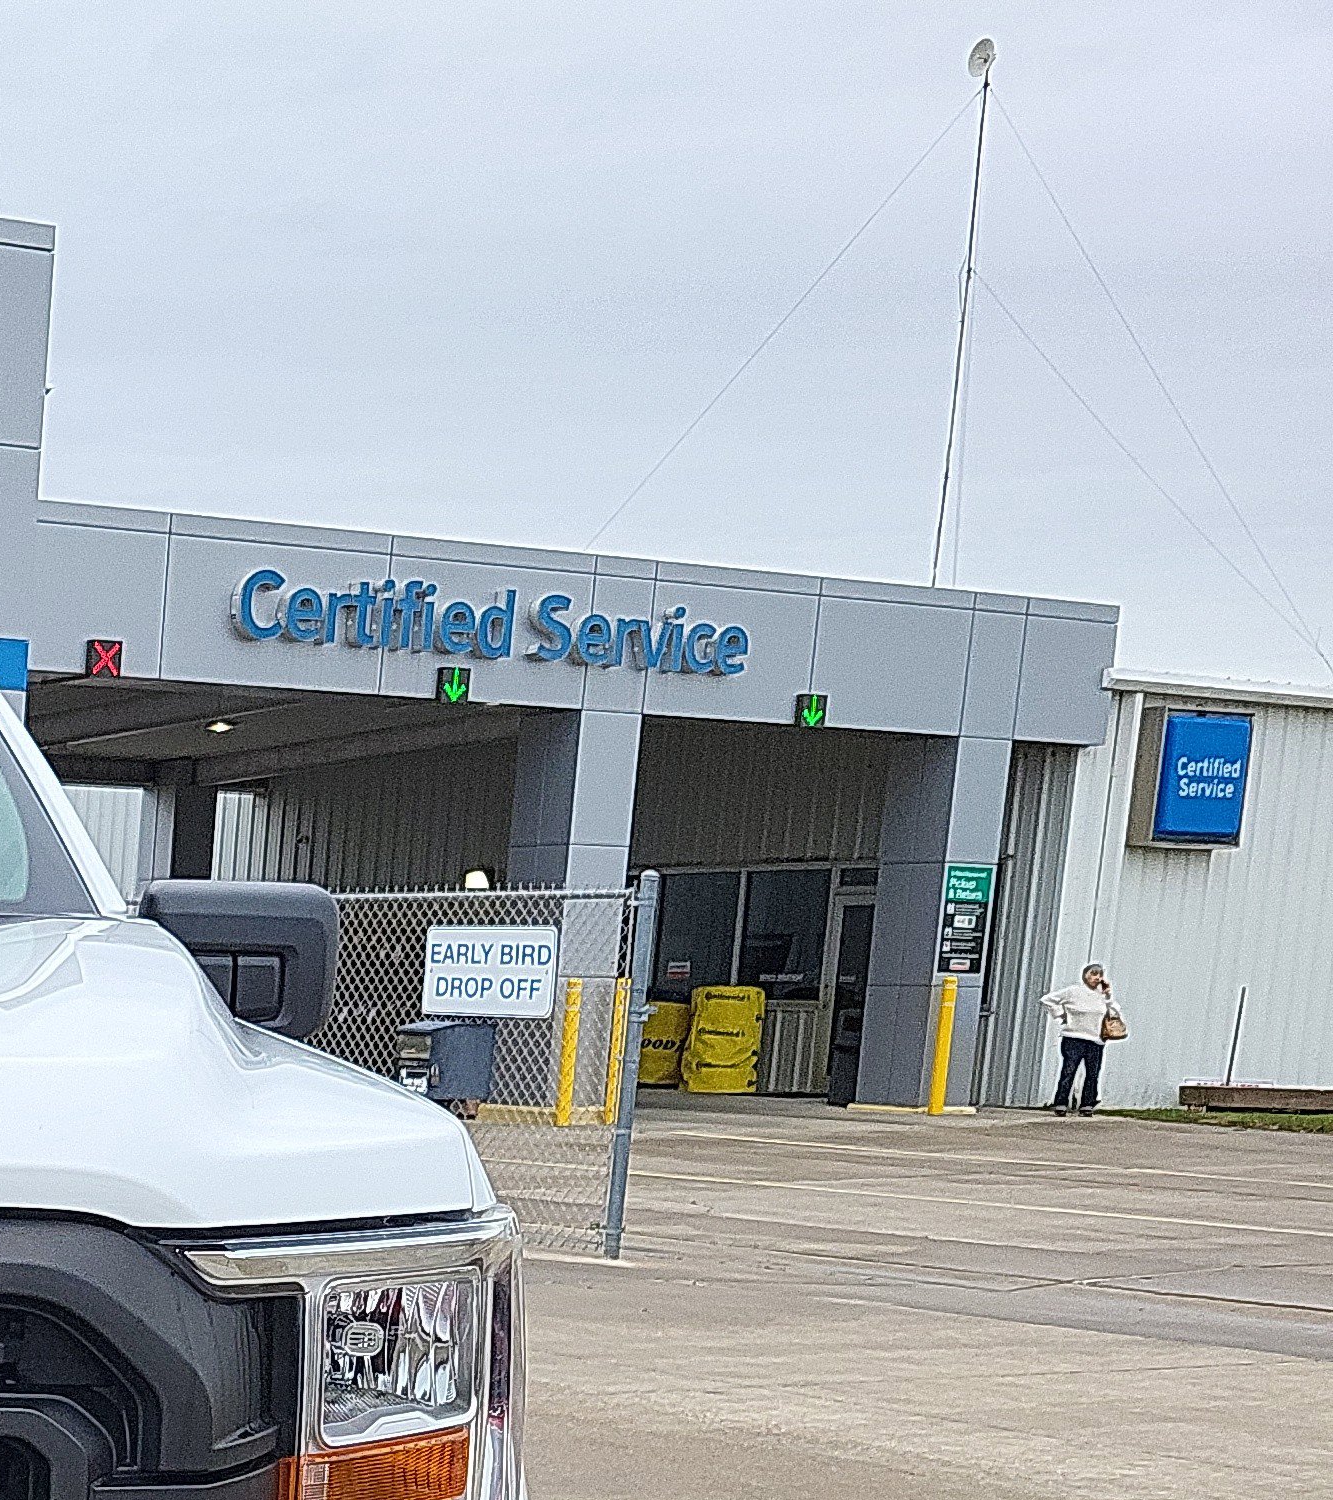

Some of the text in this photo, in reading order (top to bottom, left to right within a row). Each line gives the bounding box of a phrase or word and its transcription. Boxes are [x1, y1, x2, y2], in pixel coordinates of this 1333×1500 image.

[238, 569, 748, 675] Certified Service
[1177, 757, 1241, 799] Certified Service
[430, 943, 551, 966] EARLY BIRD
[435, 977, 541, 1000] DROP OFF
